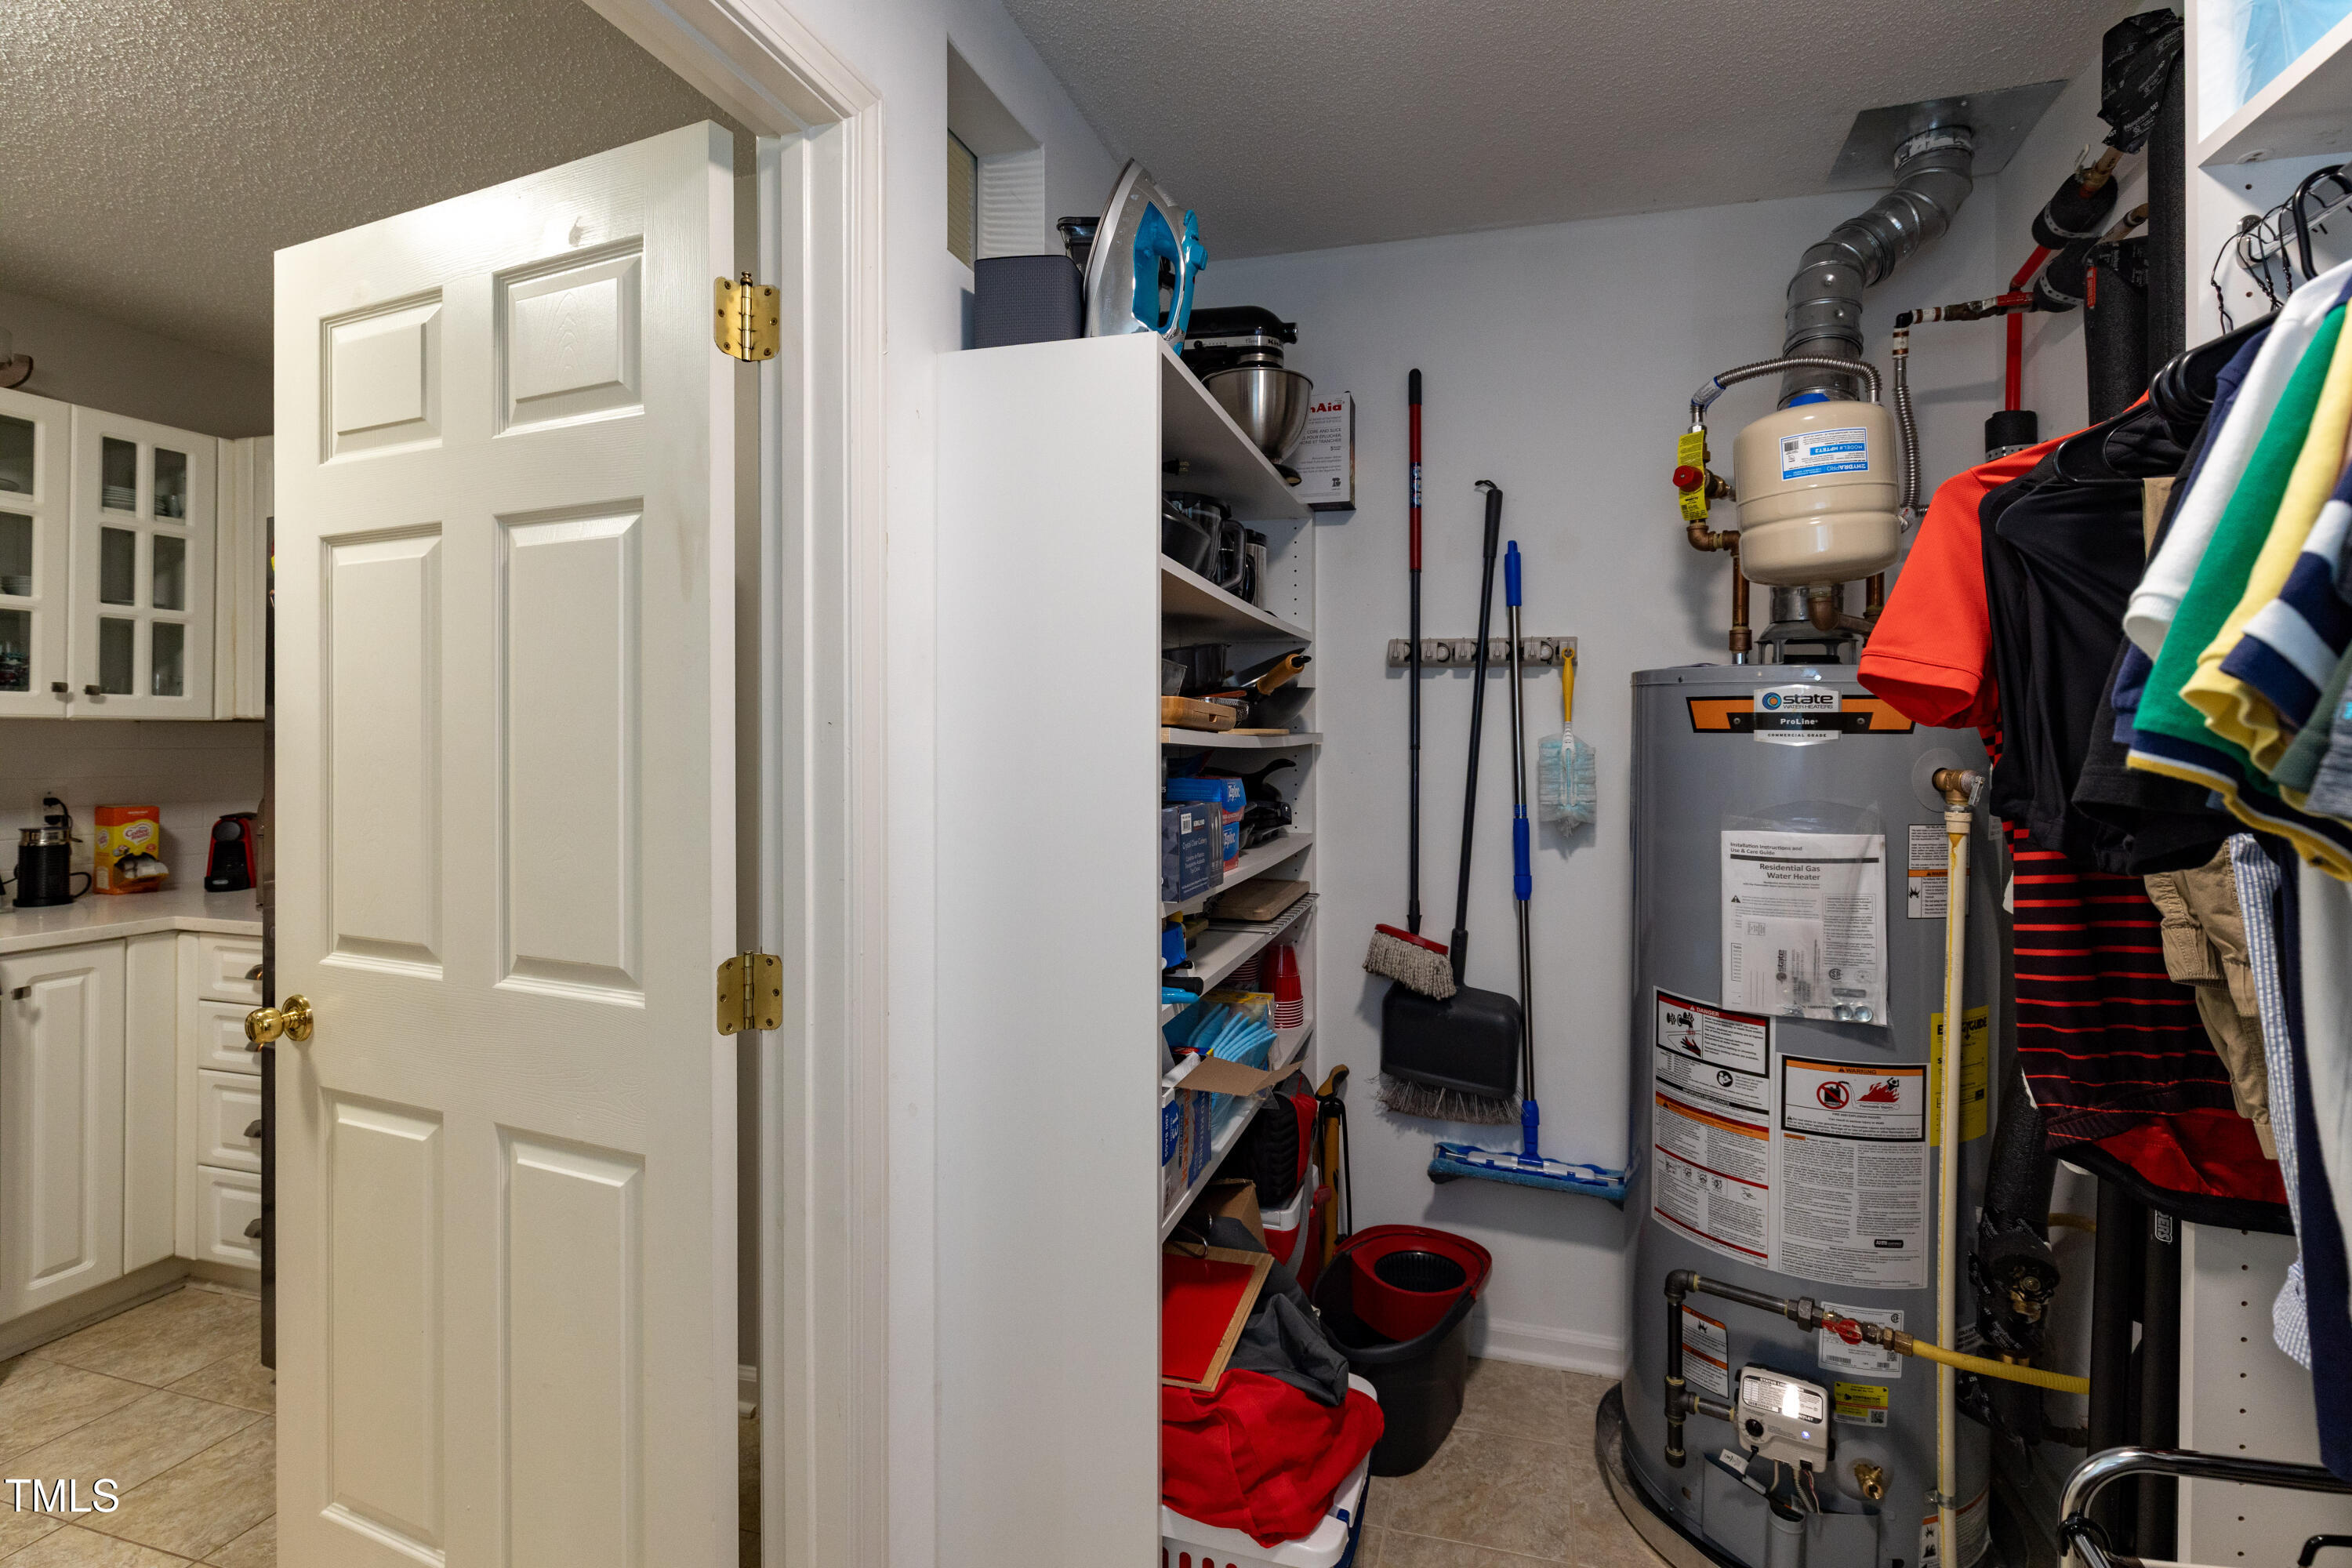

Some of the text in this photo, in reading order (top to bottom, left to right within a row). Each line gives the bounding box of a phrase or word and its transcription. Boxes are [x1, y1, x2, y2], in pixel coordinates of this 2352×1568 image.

[2150, 101, 2158, 111] 557
[1783, 694, 1833, 705] state
[1759, 863, 1804, 872] Residential
[1696, 1007, 1720, 1018] DANGER
